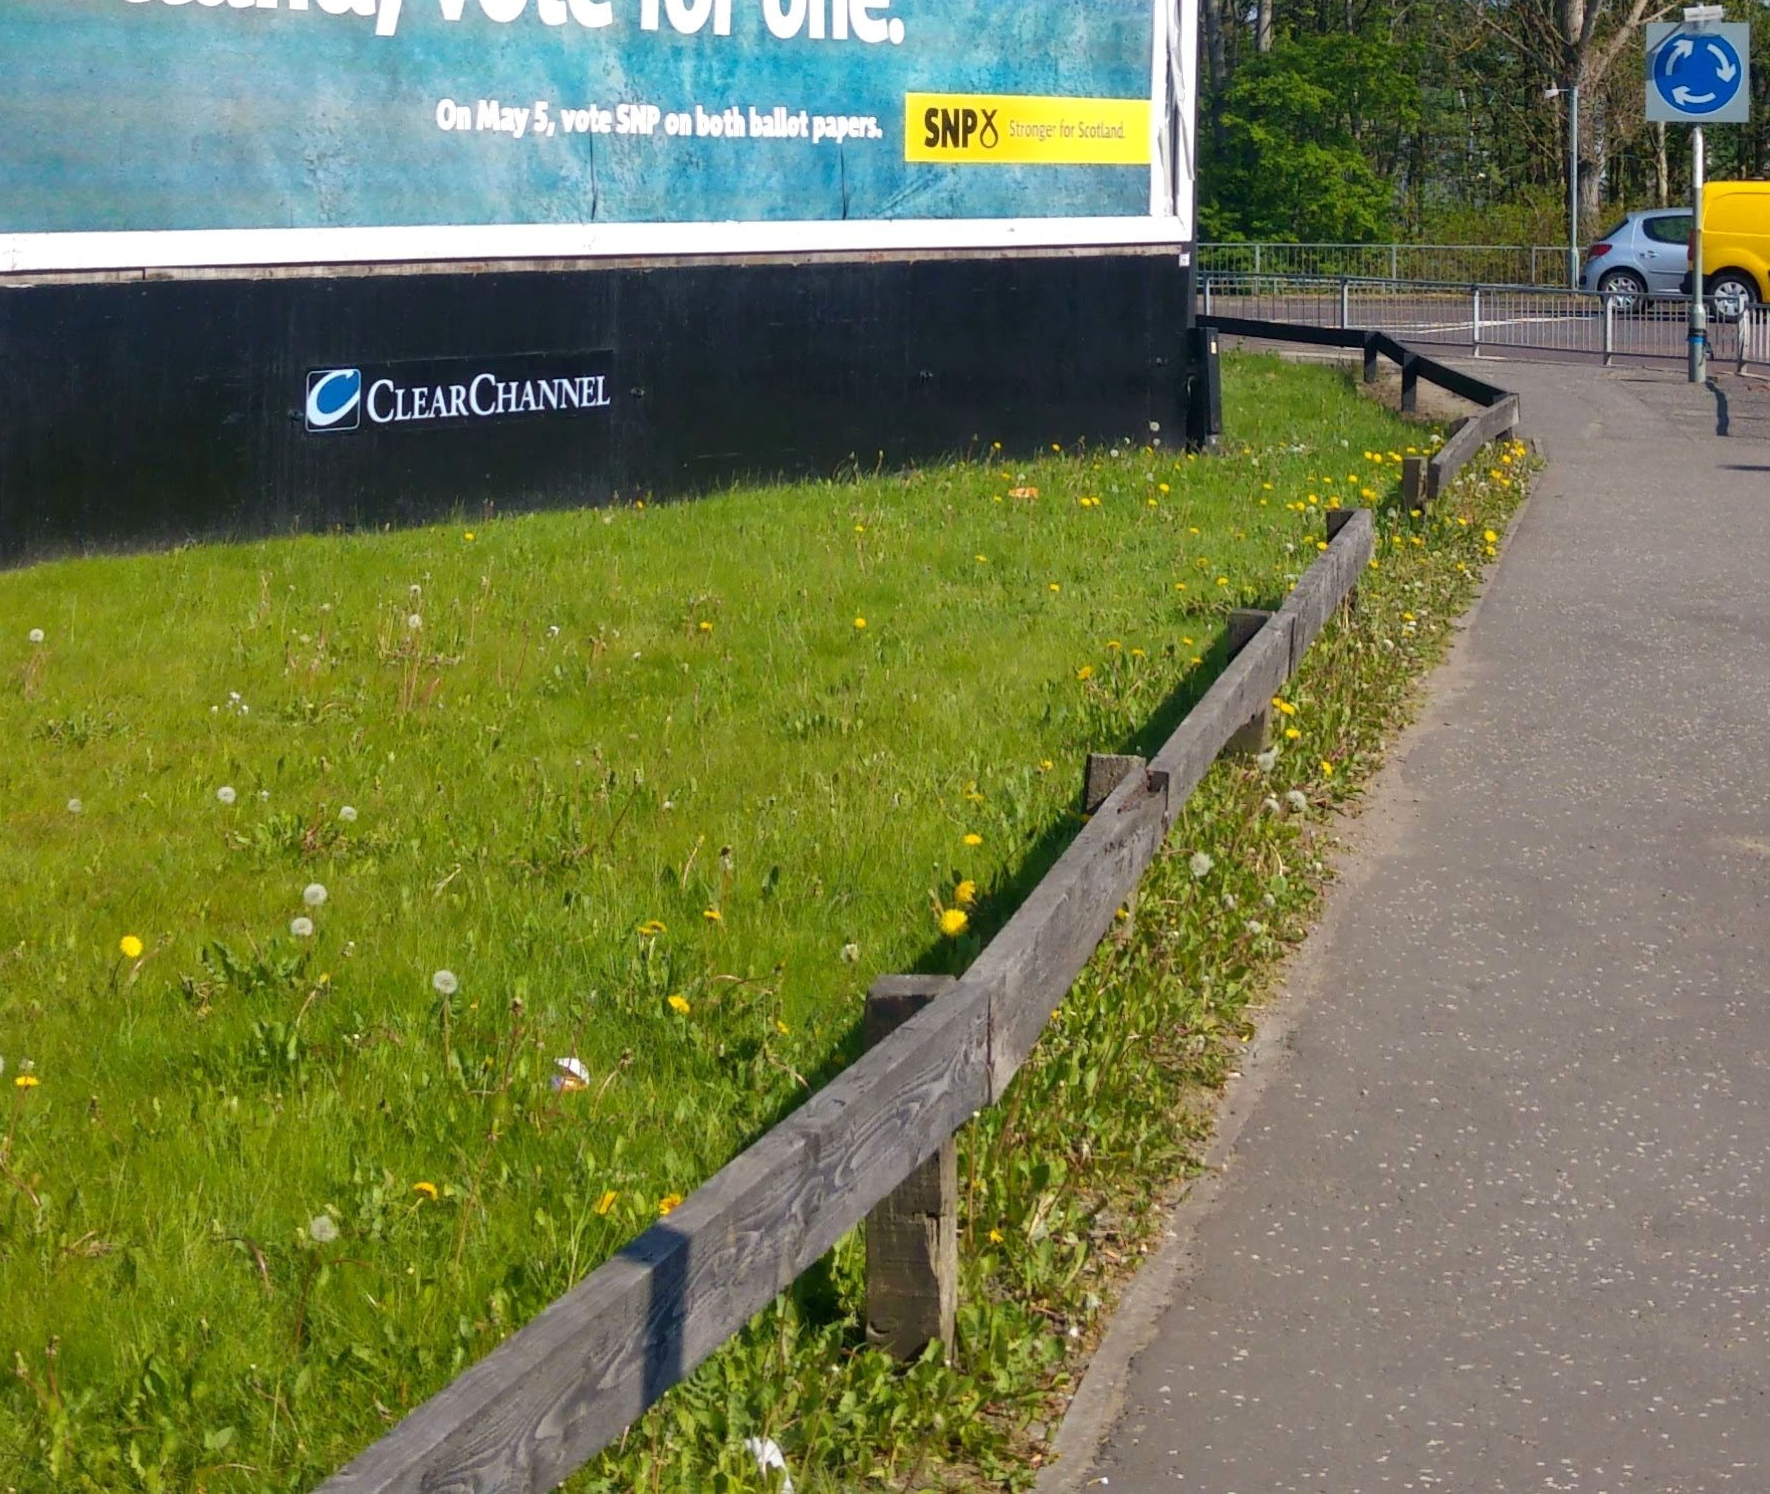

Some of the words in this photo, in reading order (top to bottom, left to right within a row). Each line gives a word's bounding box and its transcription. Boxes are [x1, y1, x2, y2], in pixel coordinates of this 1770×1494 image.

[435, 98, 473, 132] On
[474, 99, 531, 139] May
[531, 100, 556, 138] 5,
[560, 103, 615, 134] vote
[615, 103, 661, 135] SNP
[664, 112, 693, 136] on
[695, 104, 746, 139] both
[749, 106, 810, 138] ballot
[812, 115, 883, 144] papers.
[924, 107, 978, 148] SNP
[1009, 119, 1057, 141] Stronger
[1060, 119, 1075, 138] for
[1078, 121, 1126, 139] Scotland.
